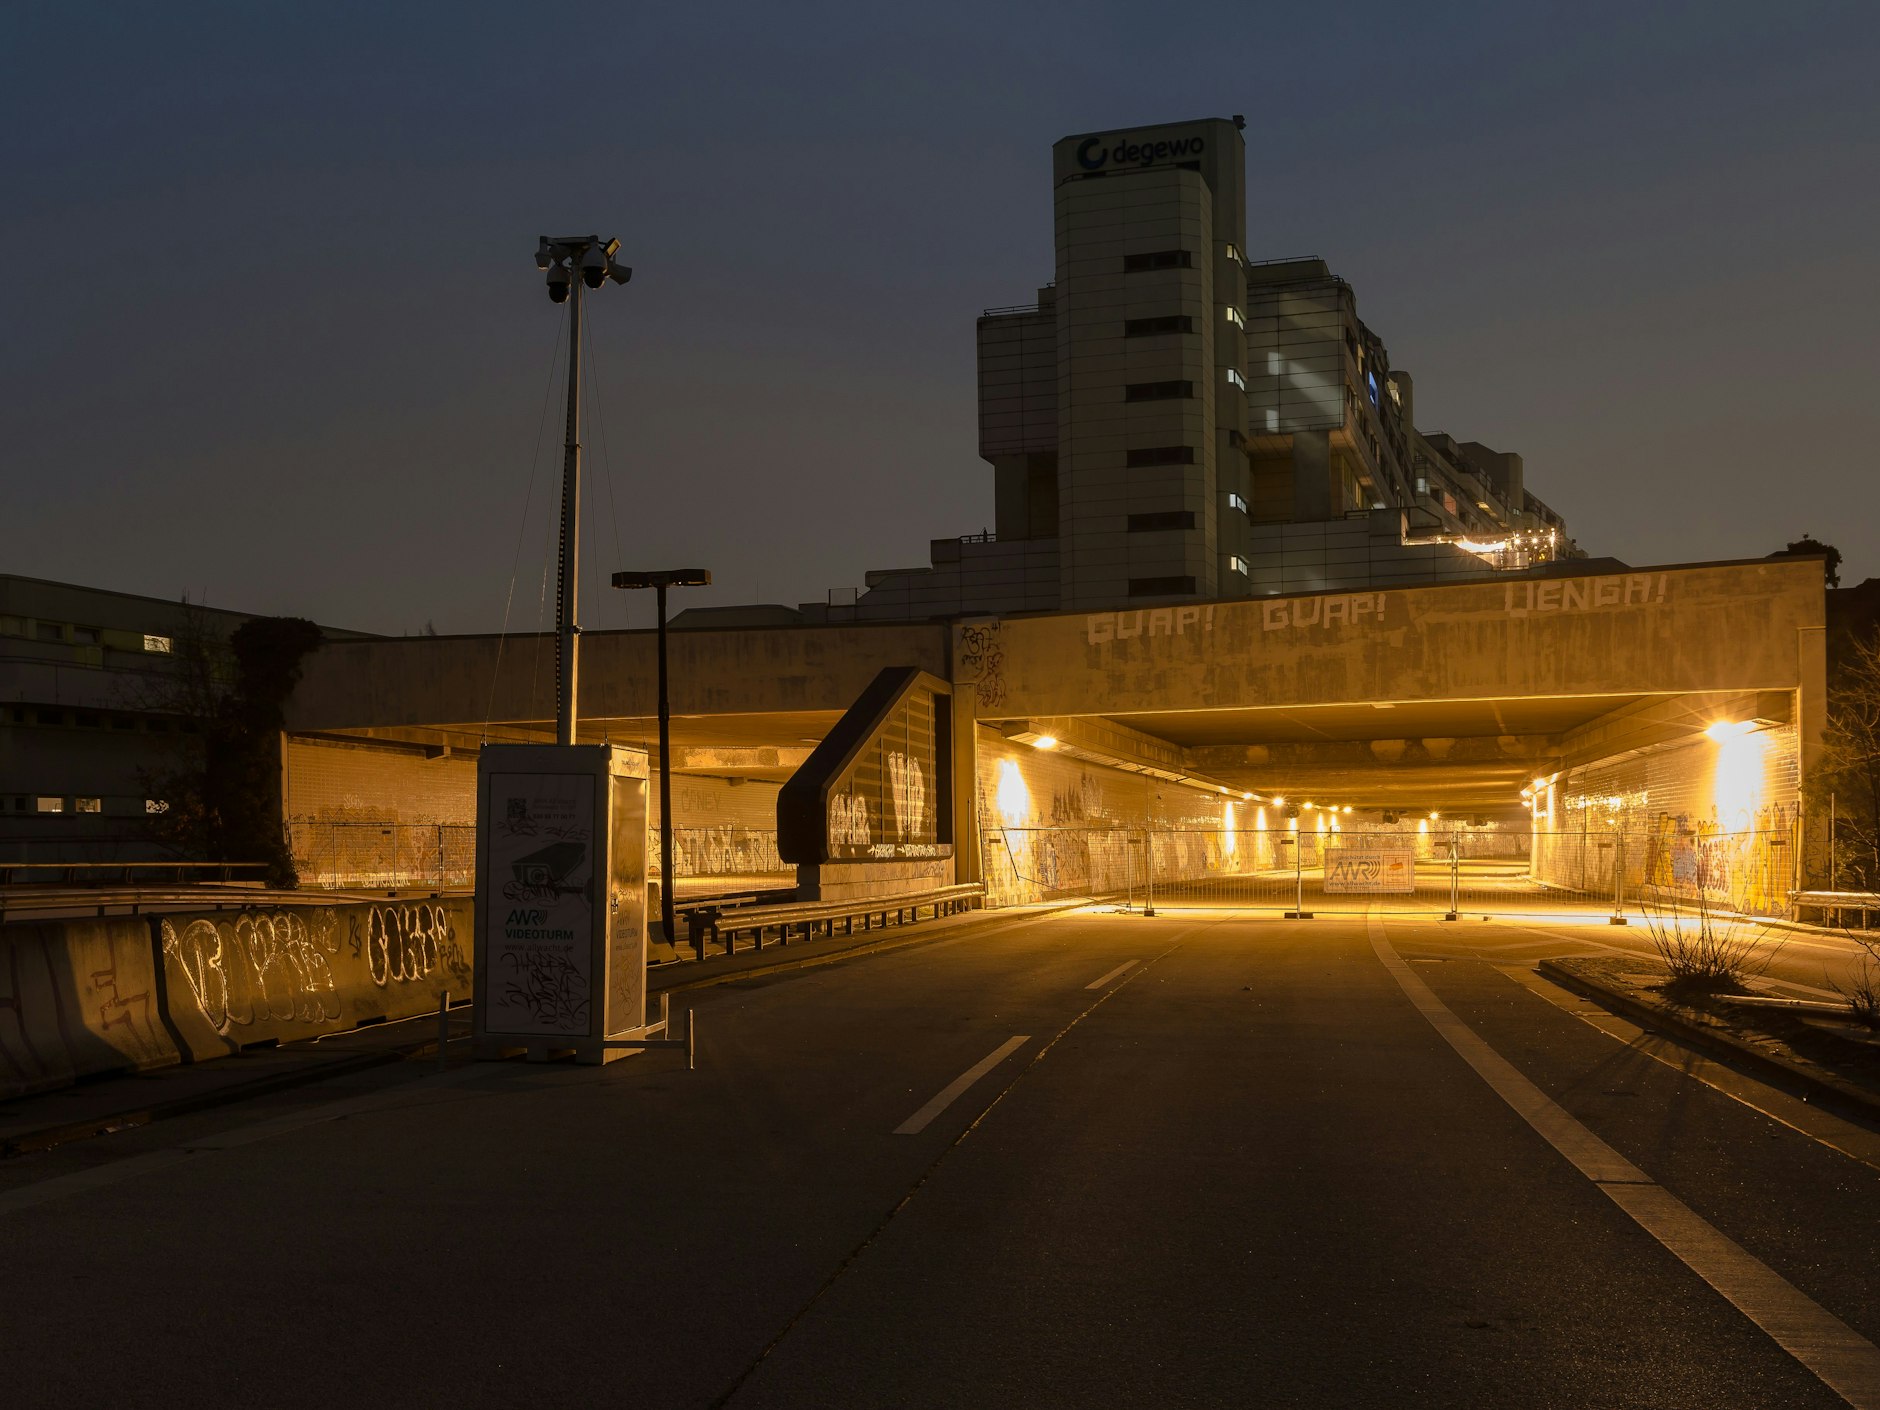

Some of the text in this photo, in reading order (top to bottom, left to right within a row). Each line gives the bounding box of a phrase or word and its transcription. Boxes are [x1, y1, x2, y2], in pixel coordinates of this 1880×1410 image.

[1113, 137, 1204, 164] degewo
[1087, 605, 1215, 646] GUAP!
[1263, 593, 1387, 632] GUAP!
[1329, 861, 1370, 881] AWR
[505, 909, 541, 926] AWR
[505, 928, 574, 940] VIDEOTURM
[504, 943, 574, 953] www.allwacht.de
